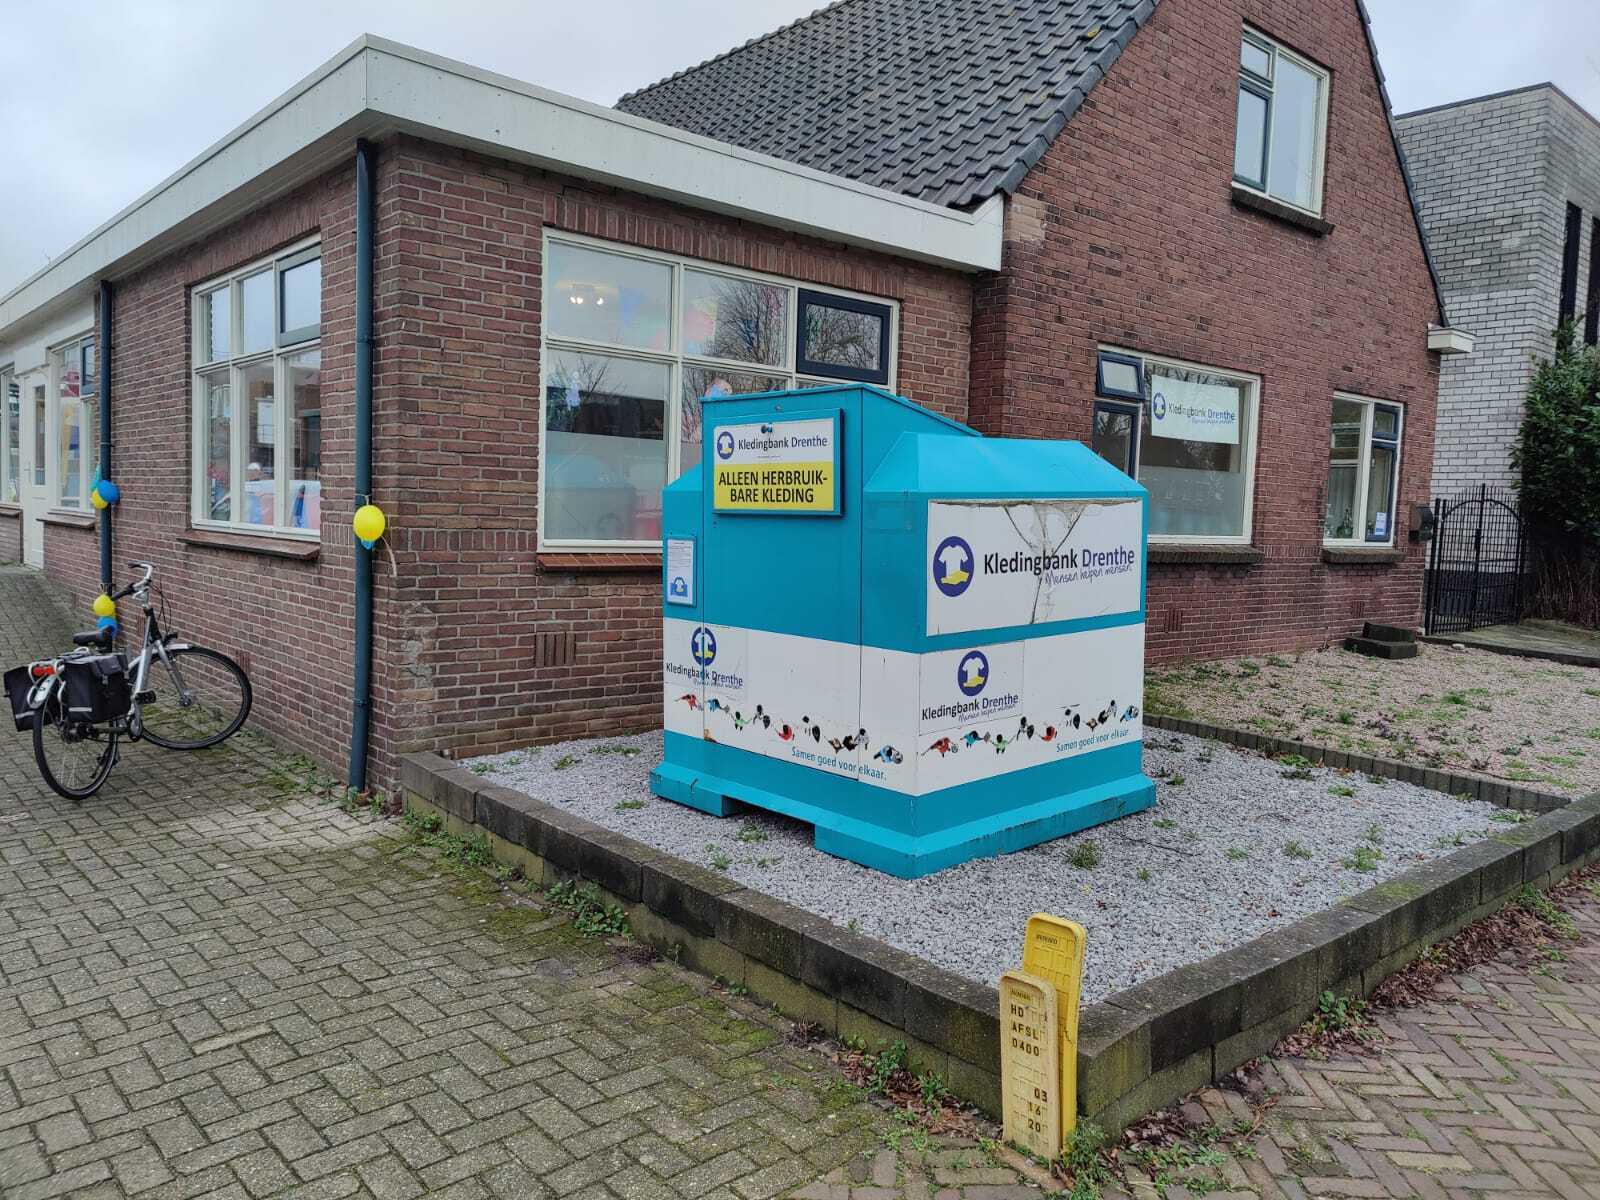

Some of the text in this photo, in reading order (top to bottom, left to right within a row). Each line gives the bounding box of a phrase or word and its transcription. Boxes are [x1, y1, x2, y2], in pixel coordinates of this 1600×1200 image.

[1207, 408, 1236, 420] Drenthe
[738, 434, 828, 452] Kledingbank Drenthe
[719, 469, 828, 486] ALLEEN HERBRUIK-
[730, 487, 814, 503] BARE KLEDING
[984, 545, 1135, 576] Kledingbank Drenthe
[665, 662, 710, 680] Kledingbak
[711, 670, 743, 687] Drenthe
[921, 698, 980, 721] Kledingbank
[982, 692, 1019, 709] Drenthe
[1056, 740, 1078, 753] Samen
[1078, 735, 1095, 750] goed
[791, 746, 816, 761] Samen
[817, 754, 837, 768] goed
[838, 761, 857, 774] voor
[1010, 1004, 1024, 1018] HD
[1012, 1021, 1039, 1041] AFSL
[1012, 1038, 1040, 1057] 0400
[1034, 1087, 1048, 1103] 03
[1027, 1118, 1041, 1132] 20
